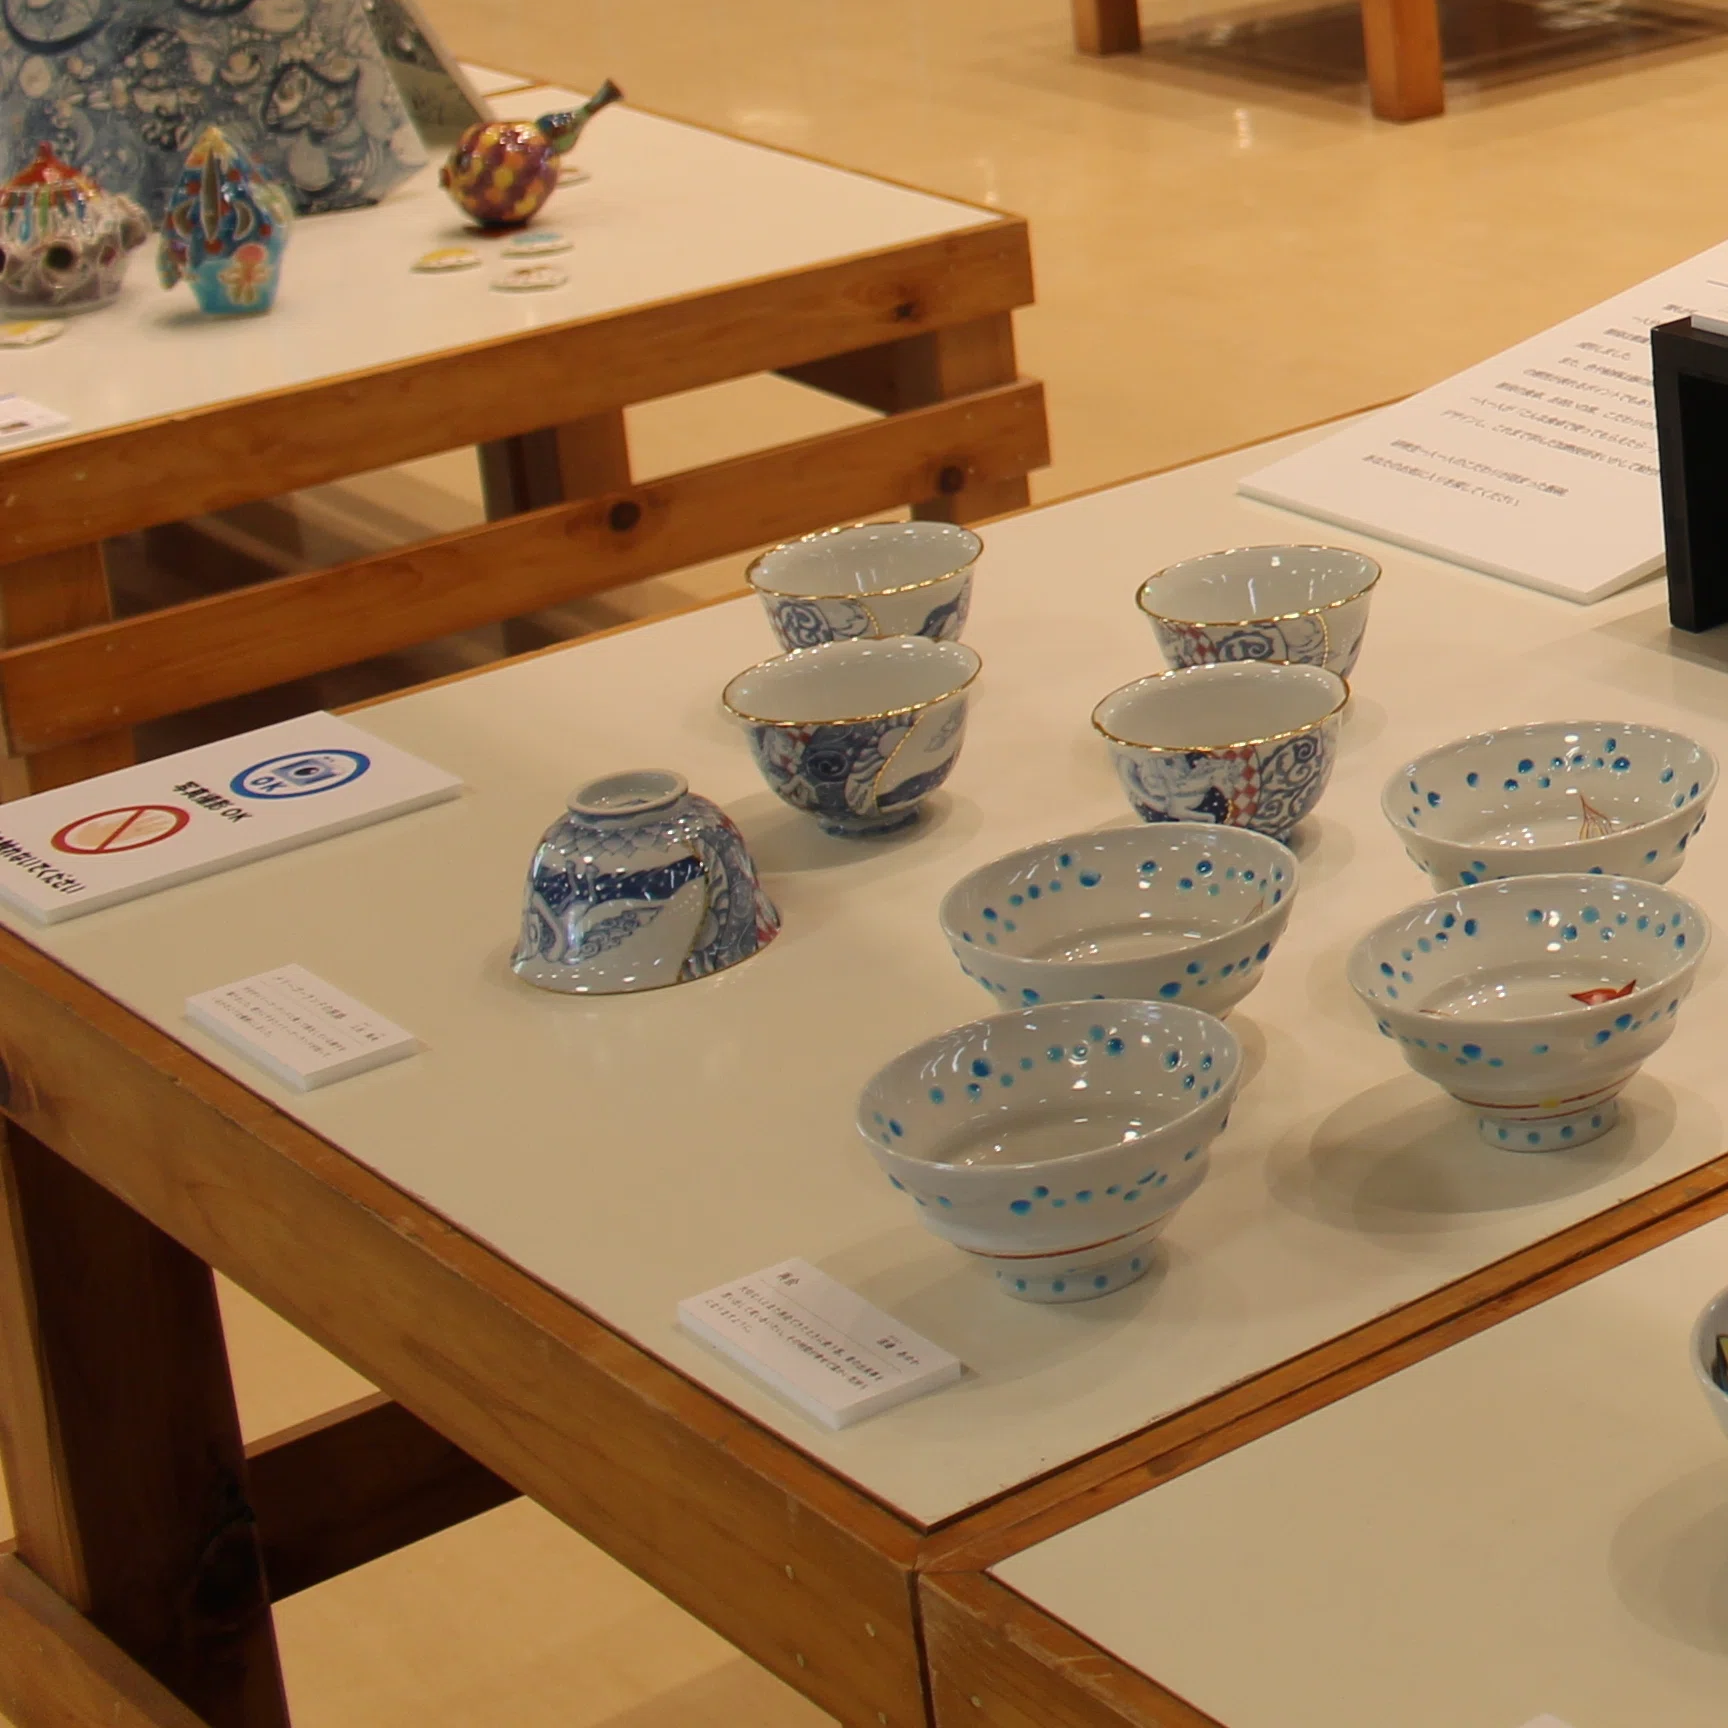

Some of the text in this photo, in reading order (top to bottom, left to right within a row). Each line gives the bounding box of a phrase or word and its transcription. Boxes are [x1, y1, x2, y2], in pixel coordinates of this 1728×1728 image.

[251, 776, 287, 792] OK
[220, 808, 252, 823] OK
[0, 836, 87, 894] 触れないでください
